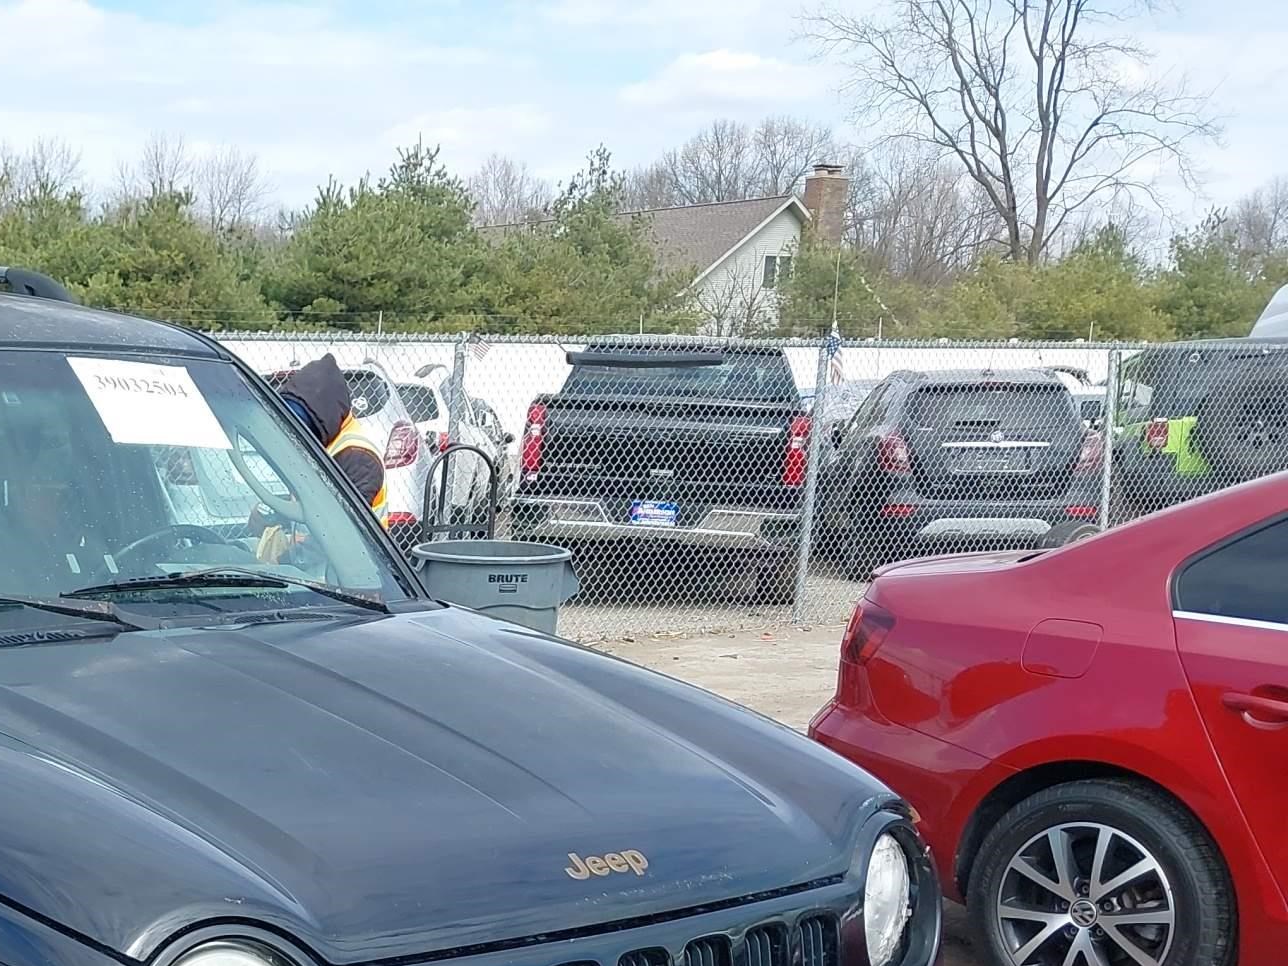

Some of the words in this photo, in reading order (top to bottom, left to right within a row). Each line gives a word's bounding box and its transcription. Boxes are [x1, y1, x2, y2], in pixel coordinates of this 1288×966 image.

[93, 373, 188, 398] 39032504
[488, 573, 529, 583] BRUTE
[564, 849, 649, 880] Jeep
